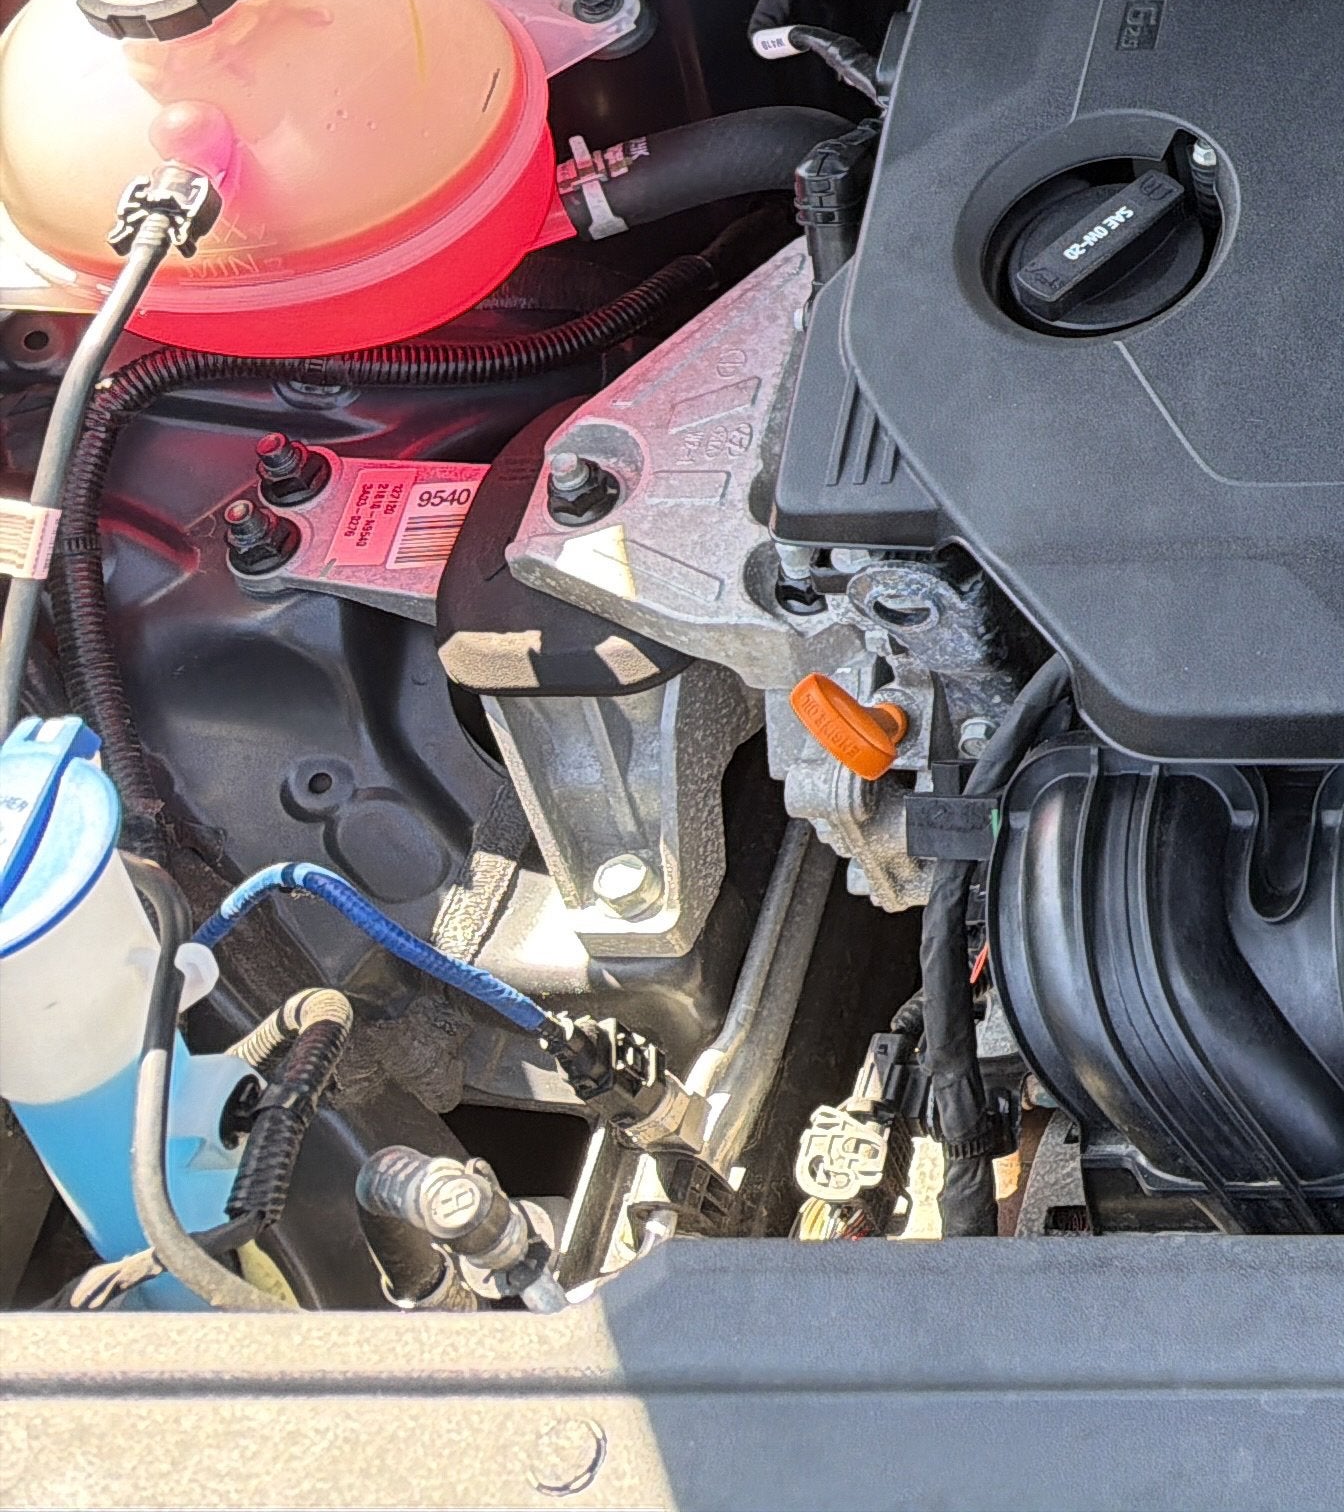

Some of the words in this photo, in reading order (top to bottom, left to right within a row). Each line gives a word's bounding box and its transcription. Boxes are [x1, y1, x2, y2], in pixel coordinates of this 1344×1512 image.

[1103, 206, 1134, 229] SAE
[1063, 226, 1108, 260] 0W-20
[417, 488, 471, 508] 9540
[801, 692, 818, 716] OIL
[815, 713, 860, 757] ENGINE
